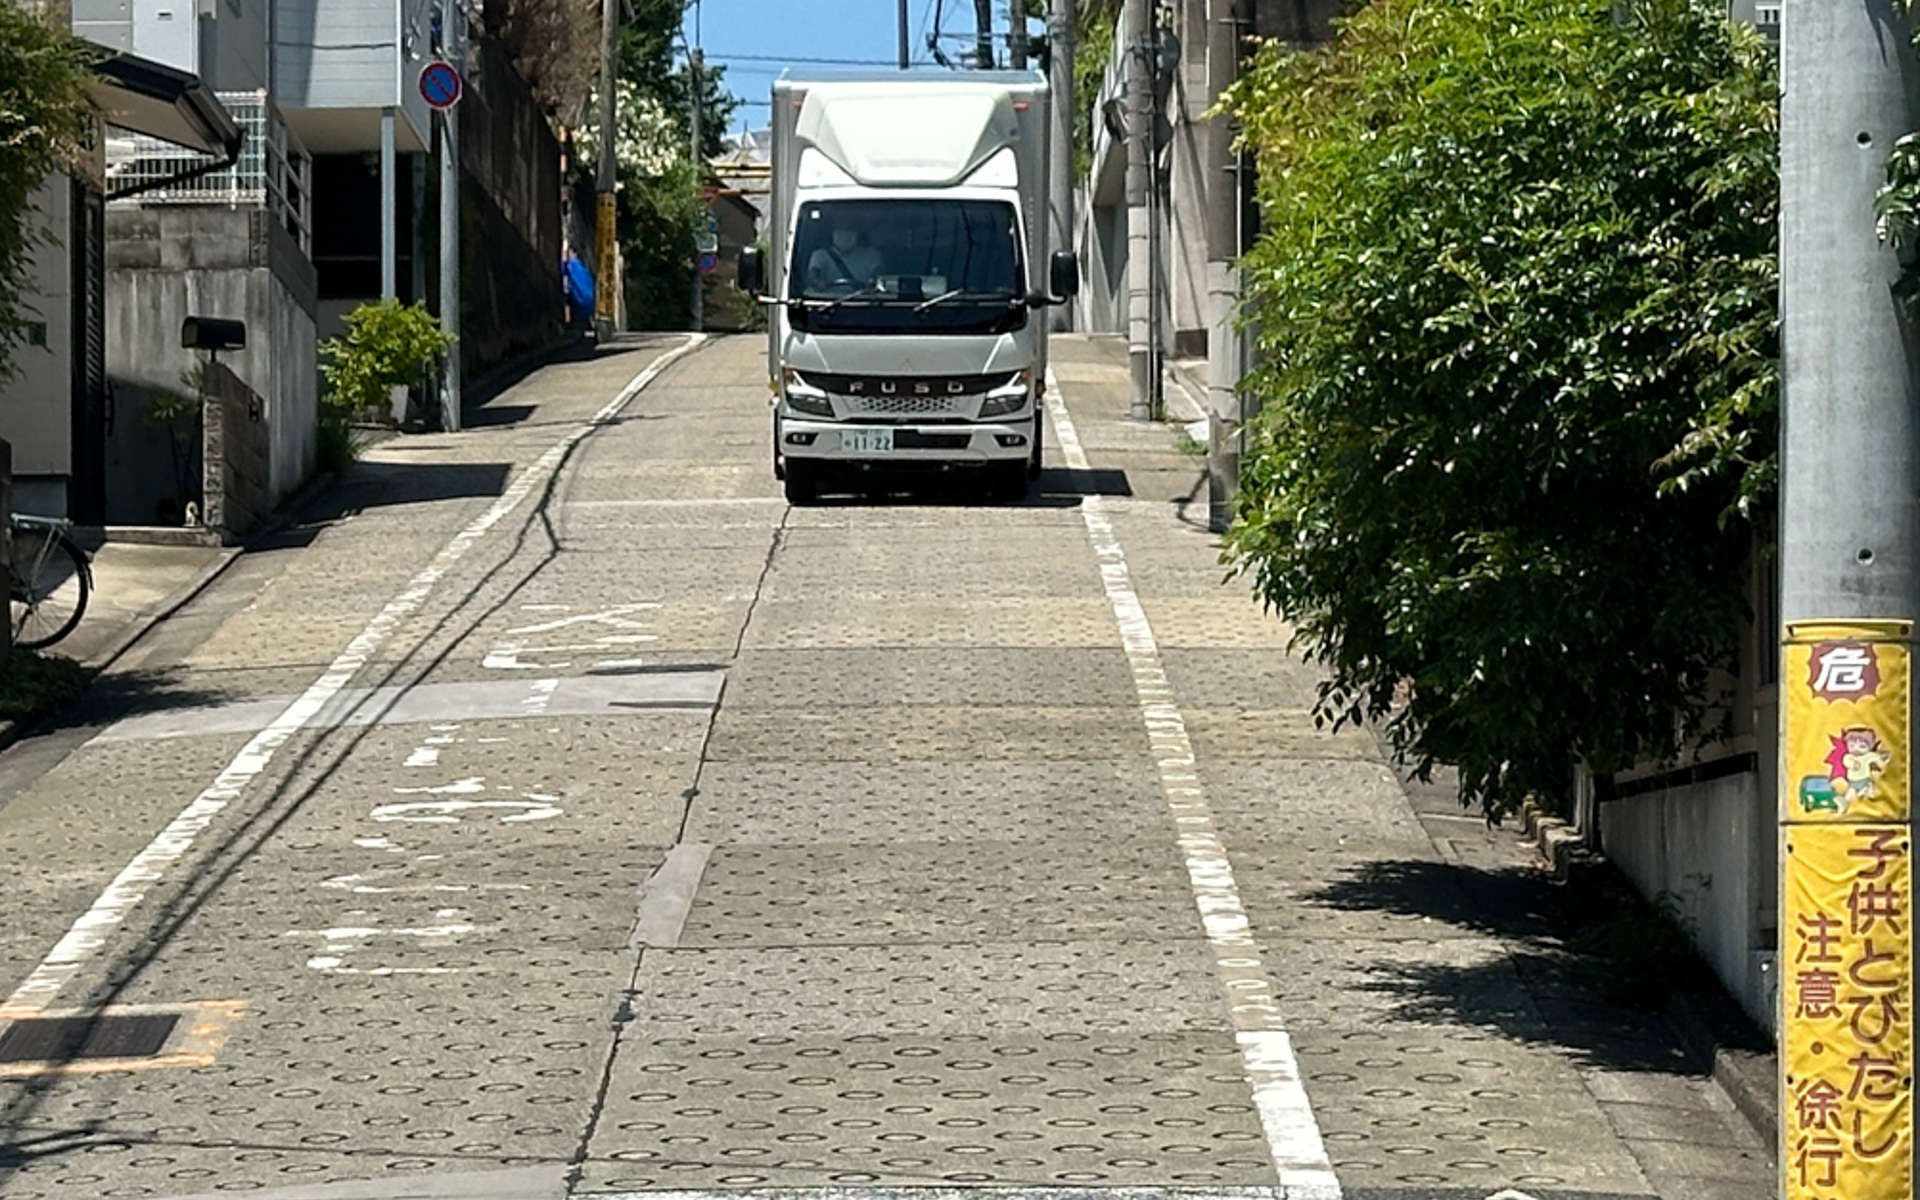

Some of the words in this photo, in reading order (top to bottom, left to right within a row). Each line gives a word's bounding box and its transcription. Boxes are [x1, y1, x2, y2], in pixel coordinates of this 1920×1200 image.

[1813, 647, 1870, 691] 危
[1847, 829, 1904, 1157] 子供とびだし
